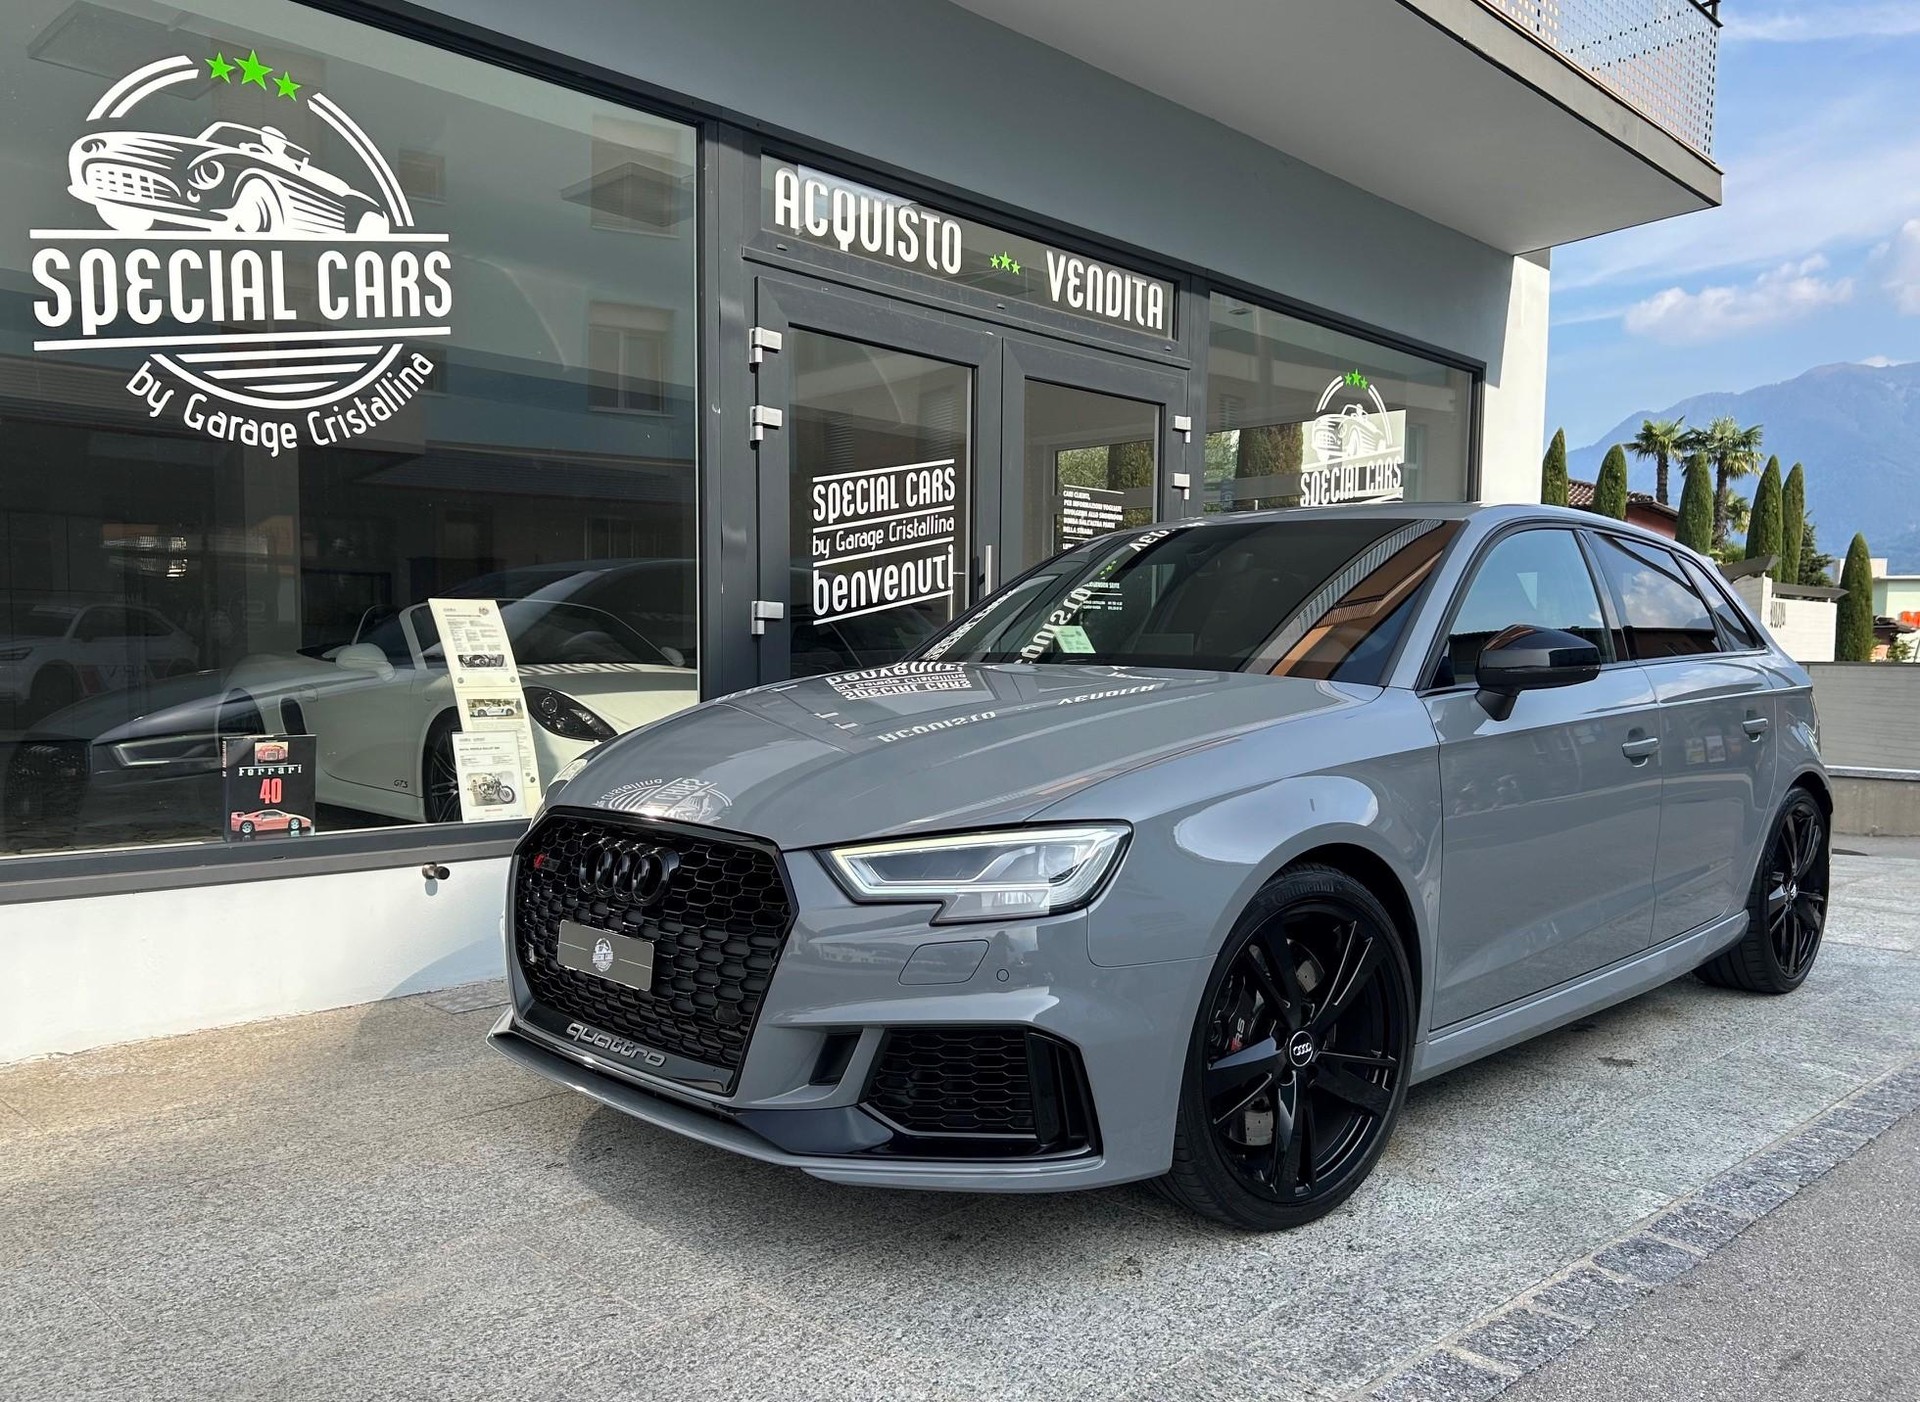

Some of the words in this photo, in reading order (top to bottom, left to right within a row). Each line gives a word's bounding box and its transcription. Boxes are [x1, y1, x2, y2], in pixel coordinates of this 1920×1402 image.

[775, 167, 962, 275] ACQUISTO
[1046, 250, 1163, 330] VENDITA
[31, 247, 298, 335] SPECIAL
[317, 249, 453, 320] CARS
[126, 360, 175, 418] by
[183, 392, 298, 458] Garage
[307, 352, 435, 446] Cristallina
[812, 474, 900, 524] SPECIAL
[905, 467, 956, 508] CARS
[1300, 463, 1361, 507] SPECIAL
[1366, 455, 1402, 491] CARS
[812, 534, 831, 559] by
[836, 529, 884, 551] Garage
[889, 514, 955, 542] Cristallina
[812, 544, 954, 616] benvenuti
[238, 764, 302, 777] Ferrari
[259, 778, 282, 805] 40
[393, 779, 409, 789] GTS
[566, 1022, 667, 1068] quattro
